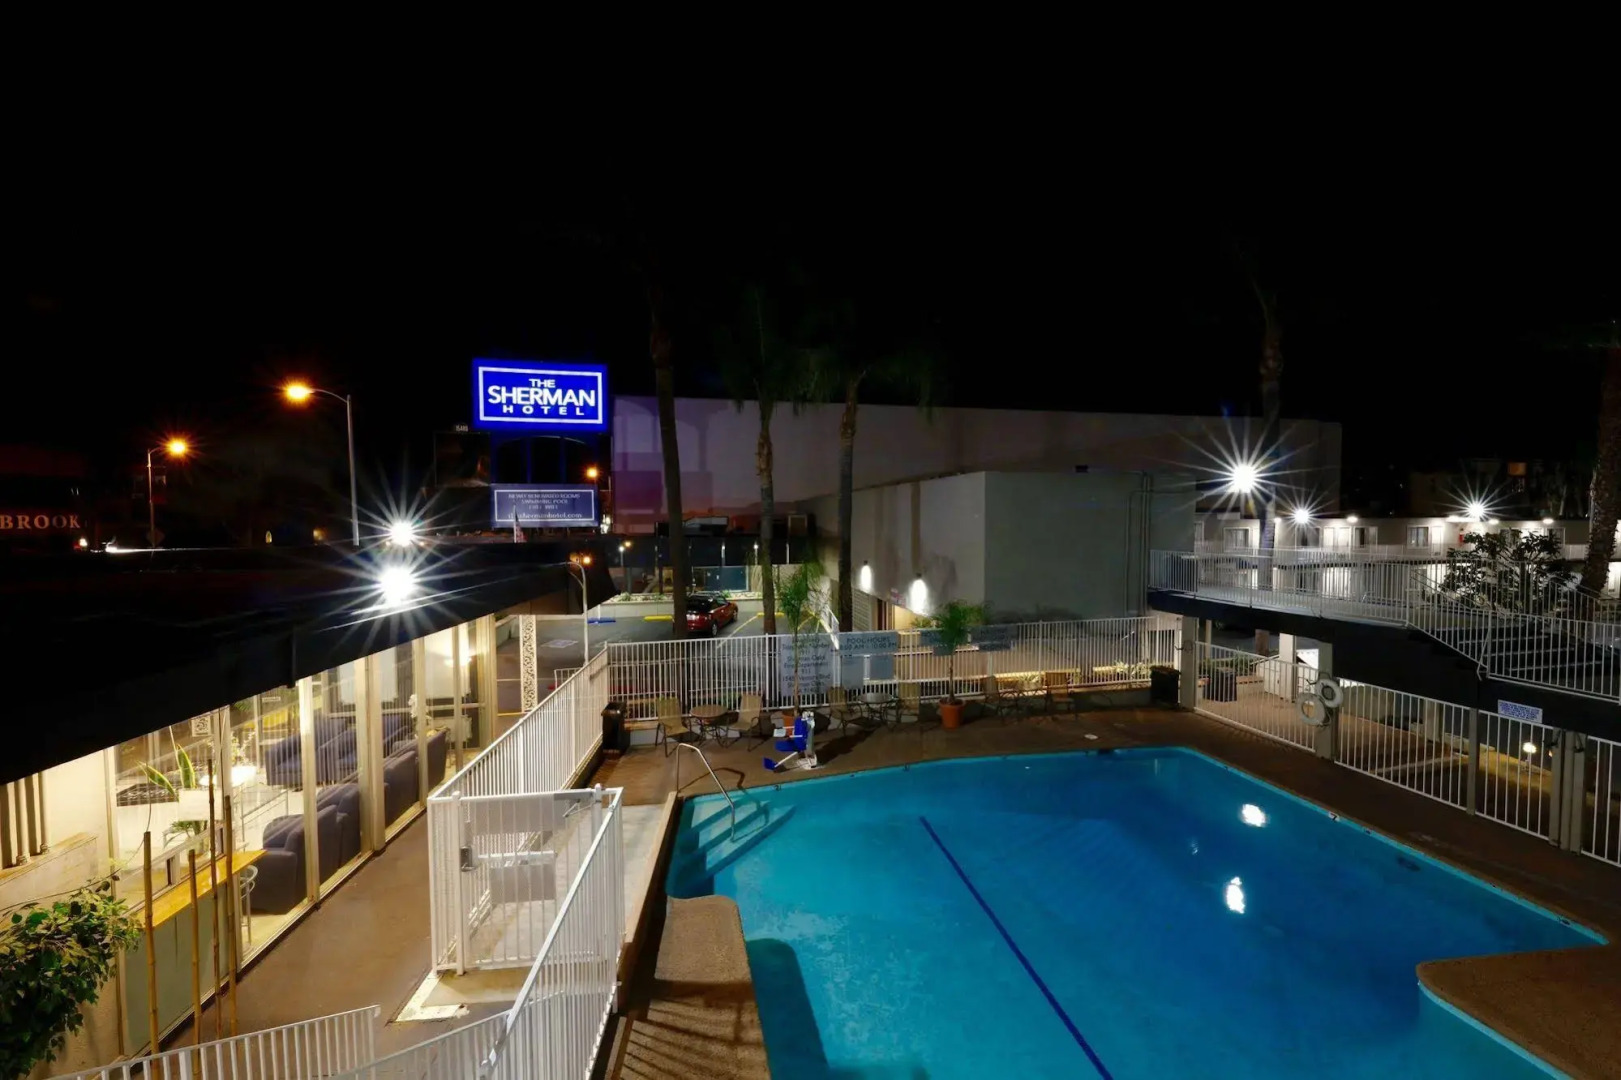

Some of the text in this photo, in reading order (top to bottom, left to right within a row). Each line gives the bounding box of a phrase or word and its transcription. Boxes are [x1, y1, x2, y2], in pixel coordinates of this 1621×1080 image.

[529, 378, 556, 388] THE
[487, 385, 596, 407] SHERMAN
[502, 404, 585, 416] HOTEL
[0, 514, 80, 529] BROOK
